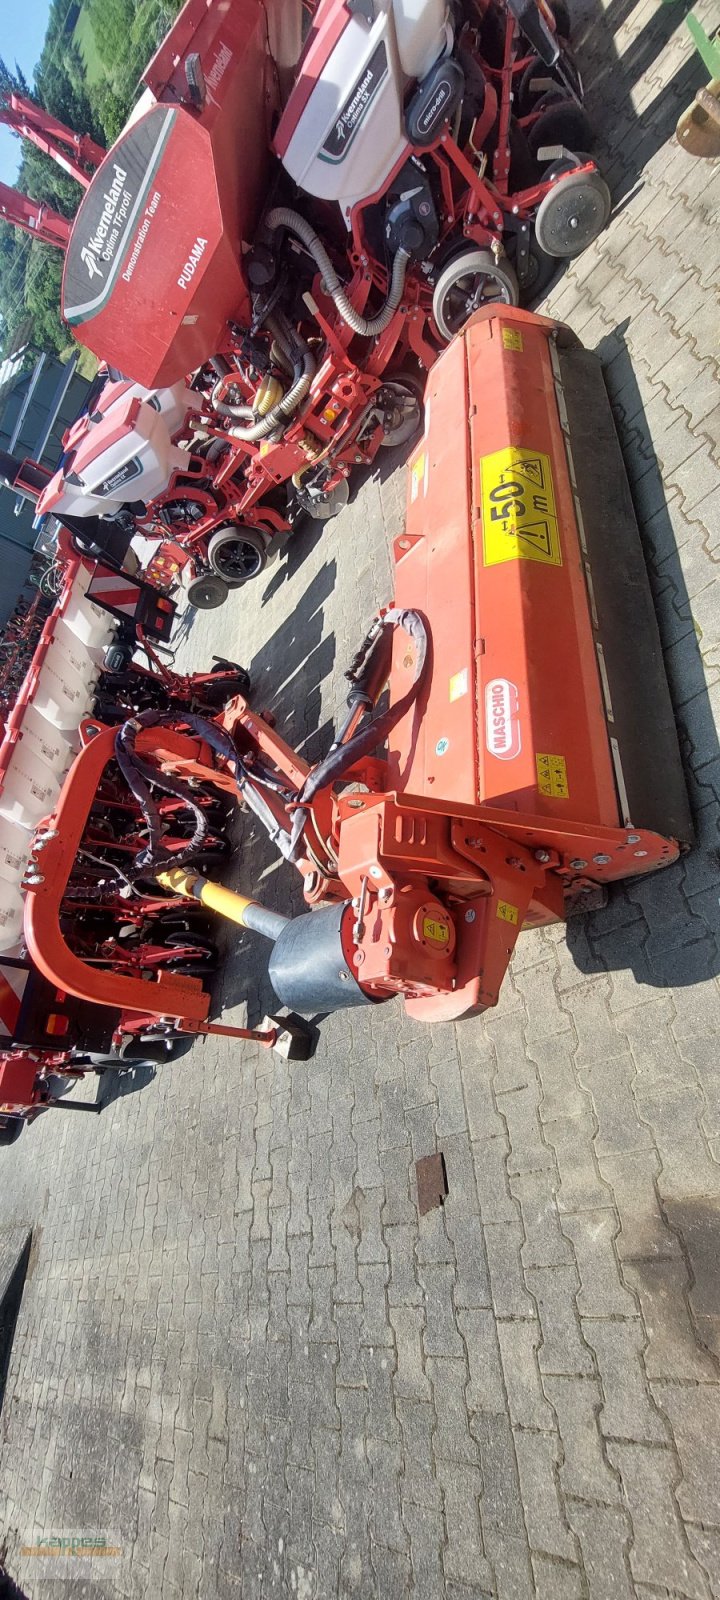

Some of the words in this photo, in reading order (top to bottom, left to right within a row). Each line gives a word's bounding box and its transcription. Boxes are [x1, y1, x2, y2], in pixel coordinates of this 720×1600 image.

[203, 40, 233, 90] Kverneland
[341, 69, 374, 123] Kverneland
[346, 104, 364, 129] Optima
[361, 92, 371, 104] SX
[423, 89, 446, 126] micro-drill
[87, 164, 128, 255] Kverneland
[101, 229, 120, 261] Optima
[112, 189, 133, 228] TFprofi
[121, 218, 151, 282] Demonstration
[144, 191, 162, 218] Team
[177, 236, 209, 290] PUDAMA
[489, 481, 526, 521] 50
[532, 495, 549, 513] m
[491, 684, 507, 749] MASCHIO
